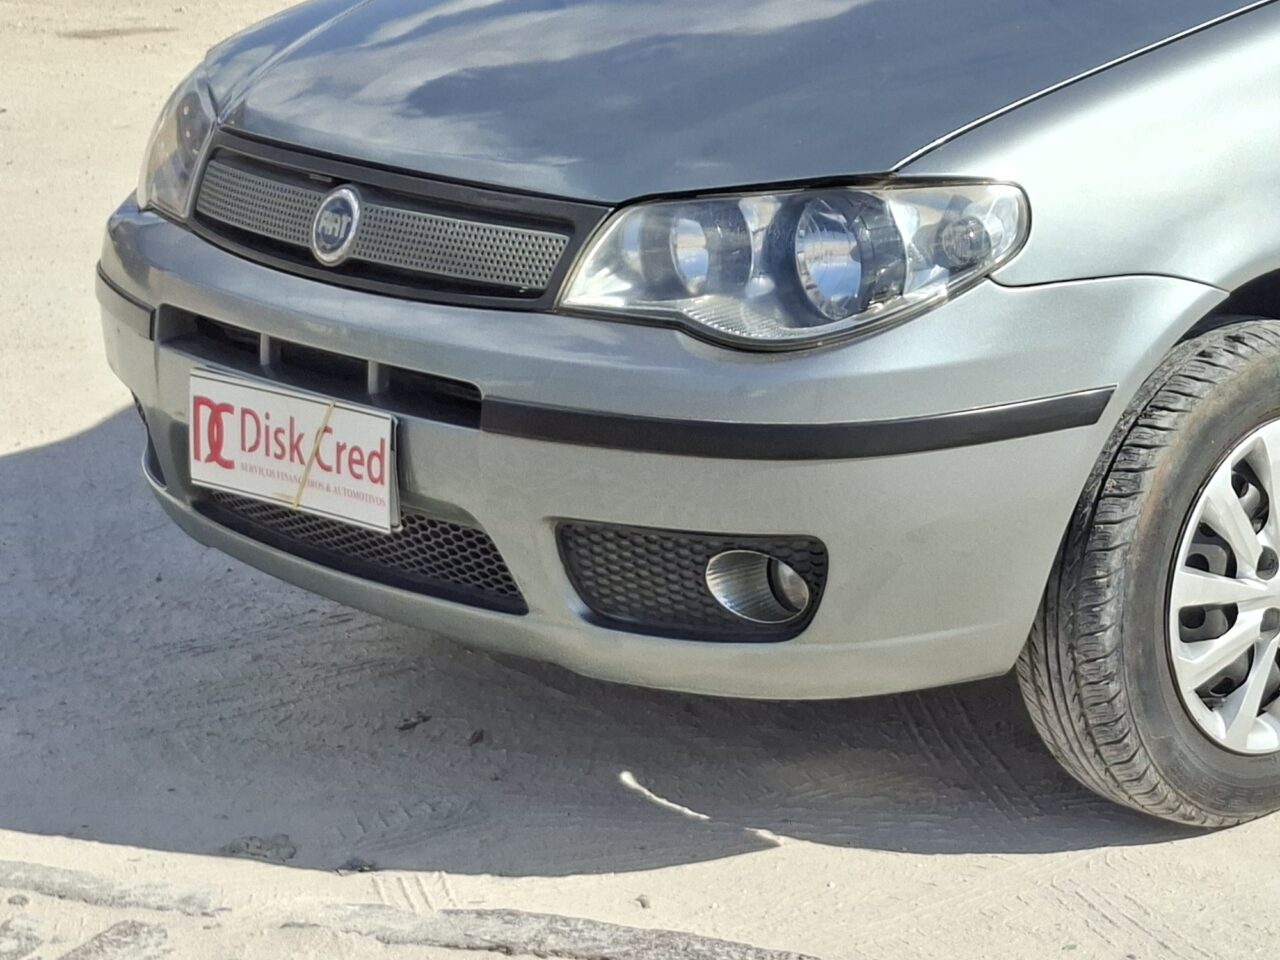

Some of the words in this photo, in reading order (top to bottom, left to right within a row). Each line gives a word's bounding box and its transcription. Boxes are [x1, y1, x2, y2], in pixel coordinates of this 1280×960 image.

[240, 406, 307, 467] Disk
[314, 424, 386, 486] Cred
[275, 470, 322, 492] FINANIROS
